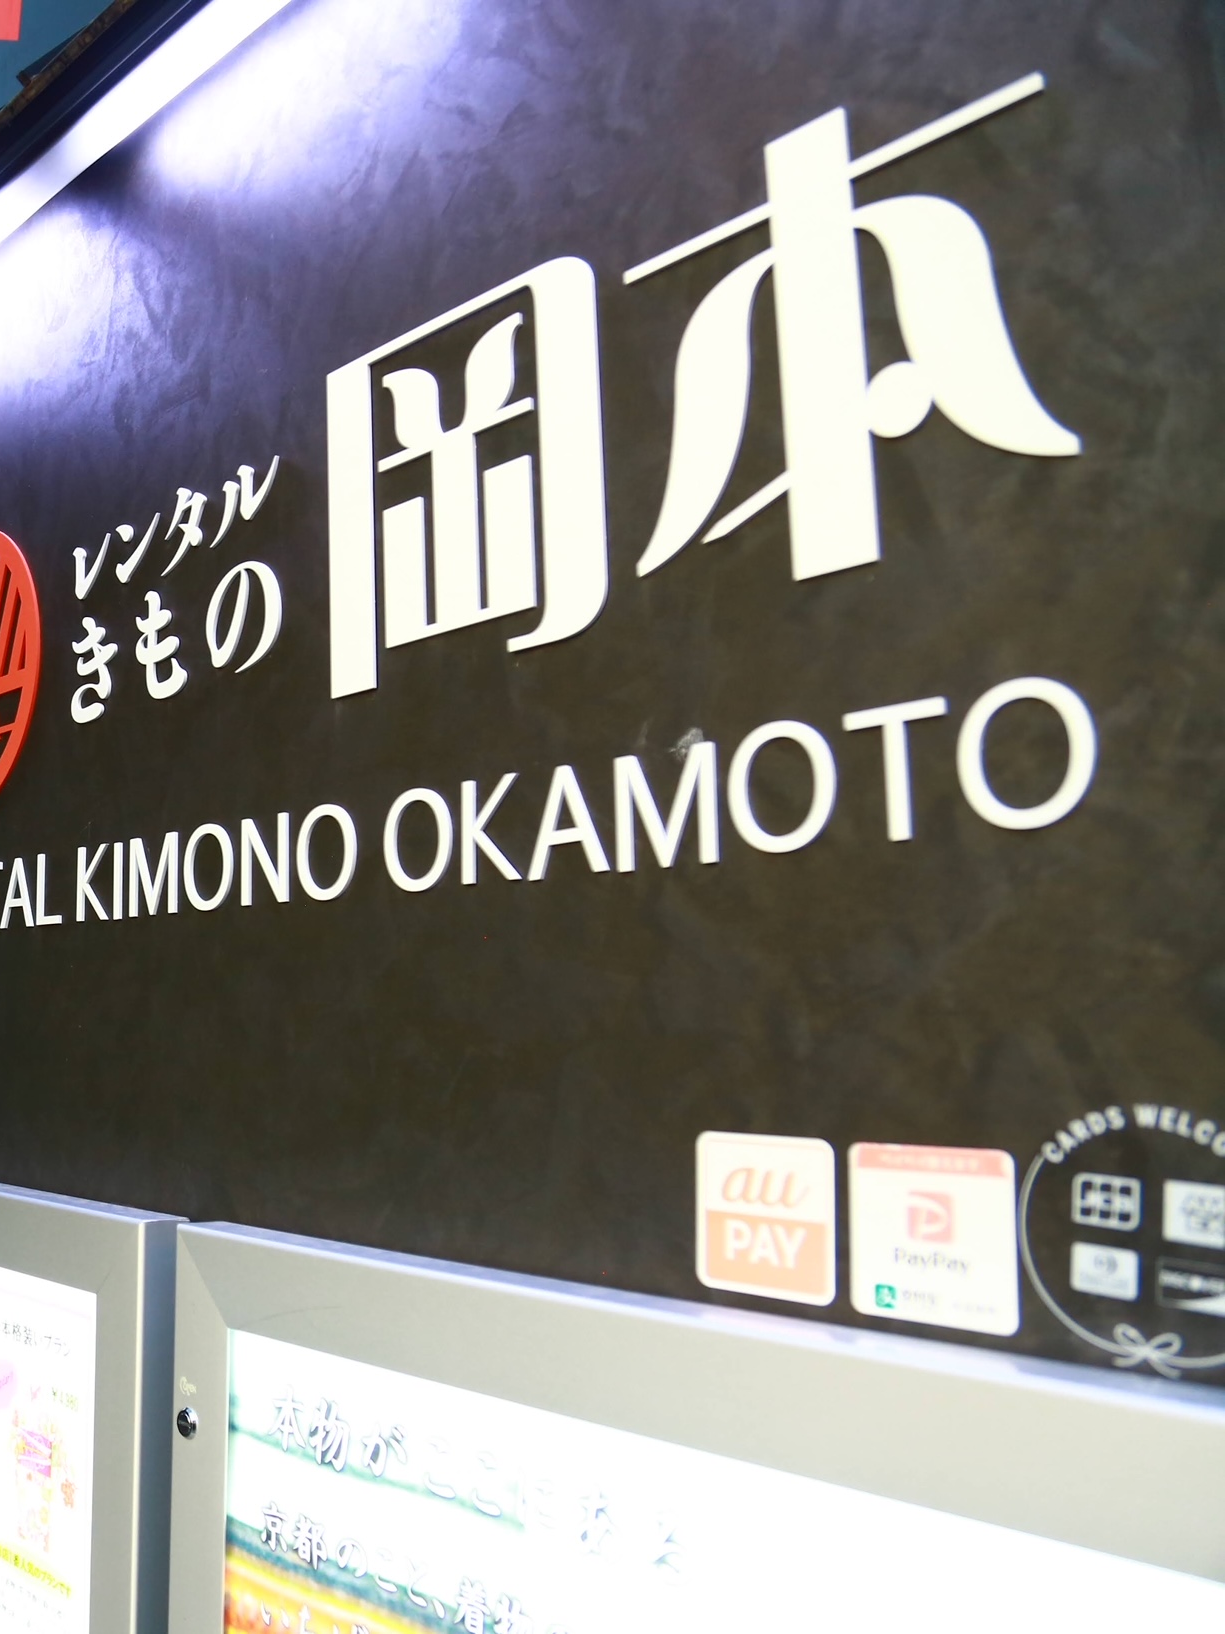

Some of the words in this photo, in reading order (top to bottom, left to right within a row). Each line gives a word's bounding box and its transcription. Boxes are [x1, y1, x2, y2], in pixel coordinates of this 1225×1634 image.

[326, 72, 1082, 699] 岡本
[72, 455, 279, 600] レンタル
[71, 560, 283, 723] きもの
[76, 803, 358, 922] KIMONO
[384, 676, 1099, 895] OKAMOTO
[721, 1167, 810, 1209] au
[1041, 1105, 1126, 1164] CARDS
[725, 1219, 806, 1269] PAY
[893, 1247, 970, 1276] PayPay
[261, 1501, 574, 1634] 京都のこと、着物
